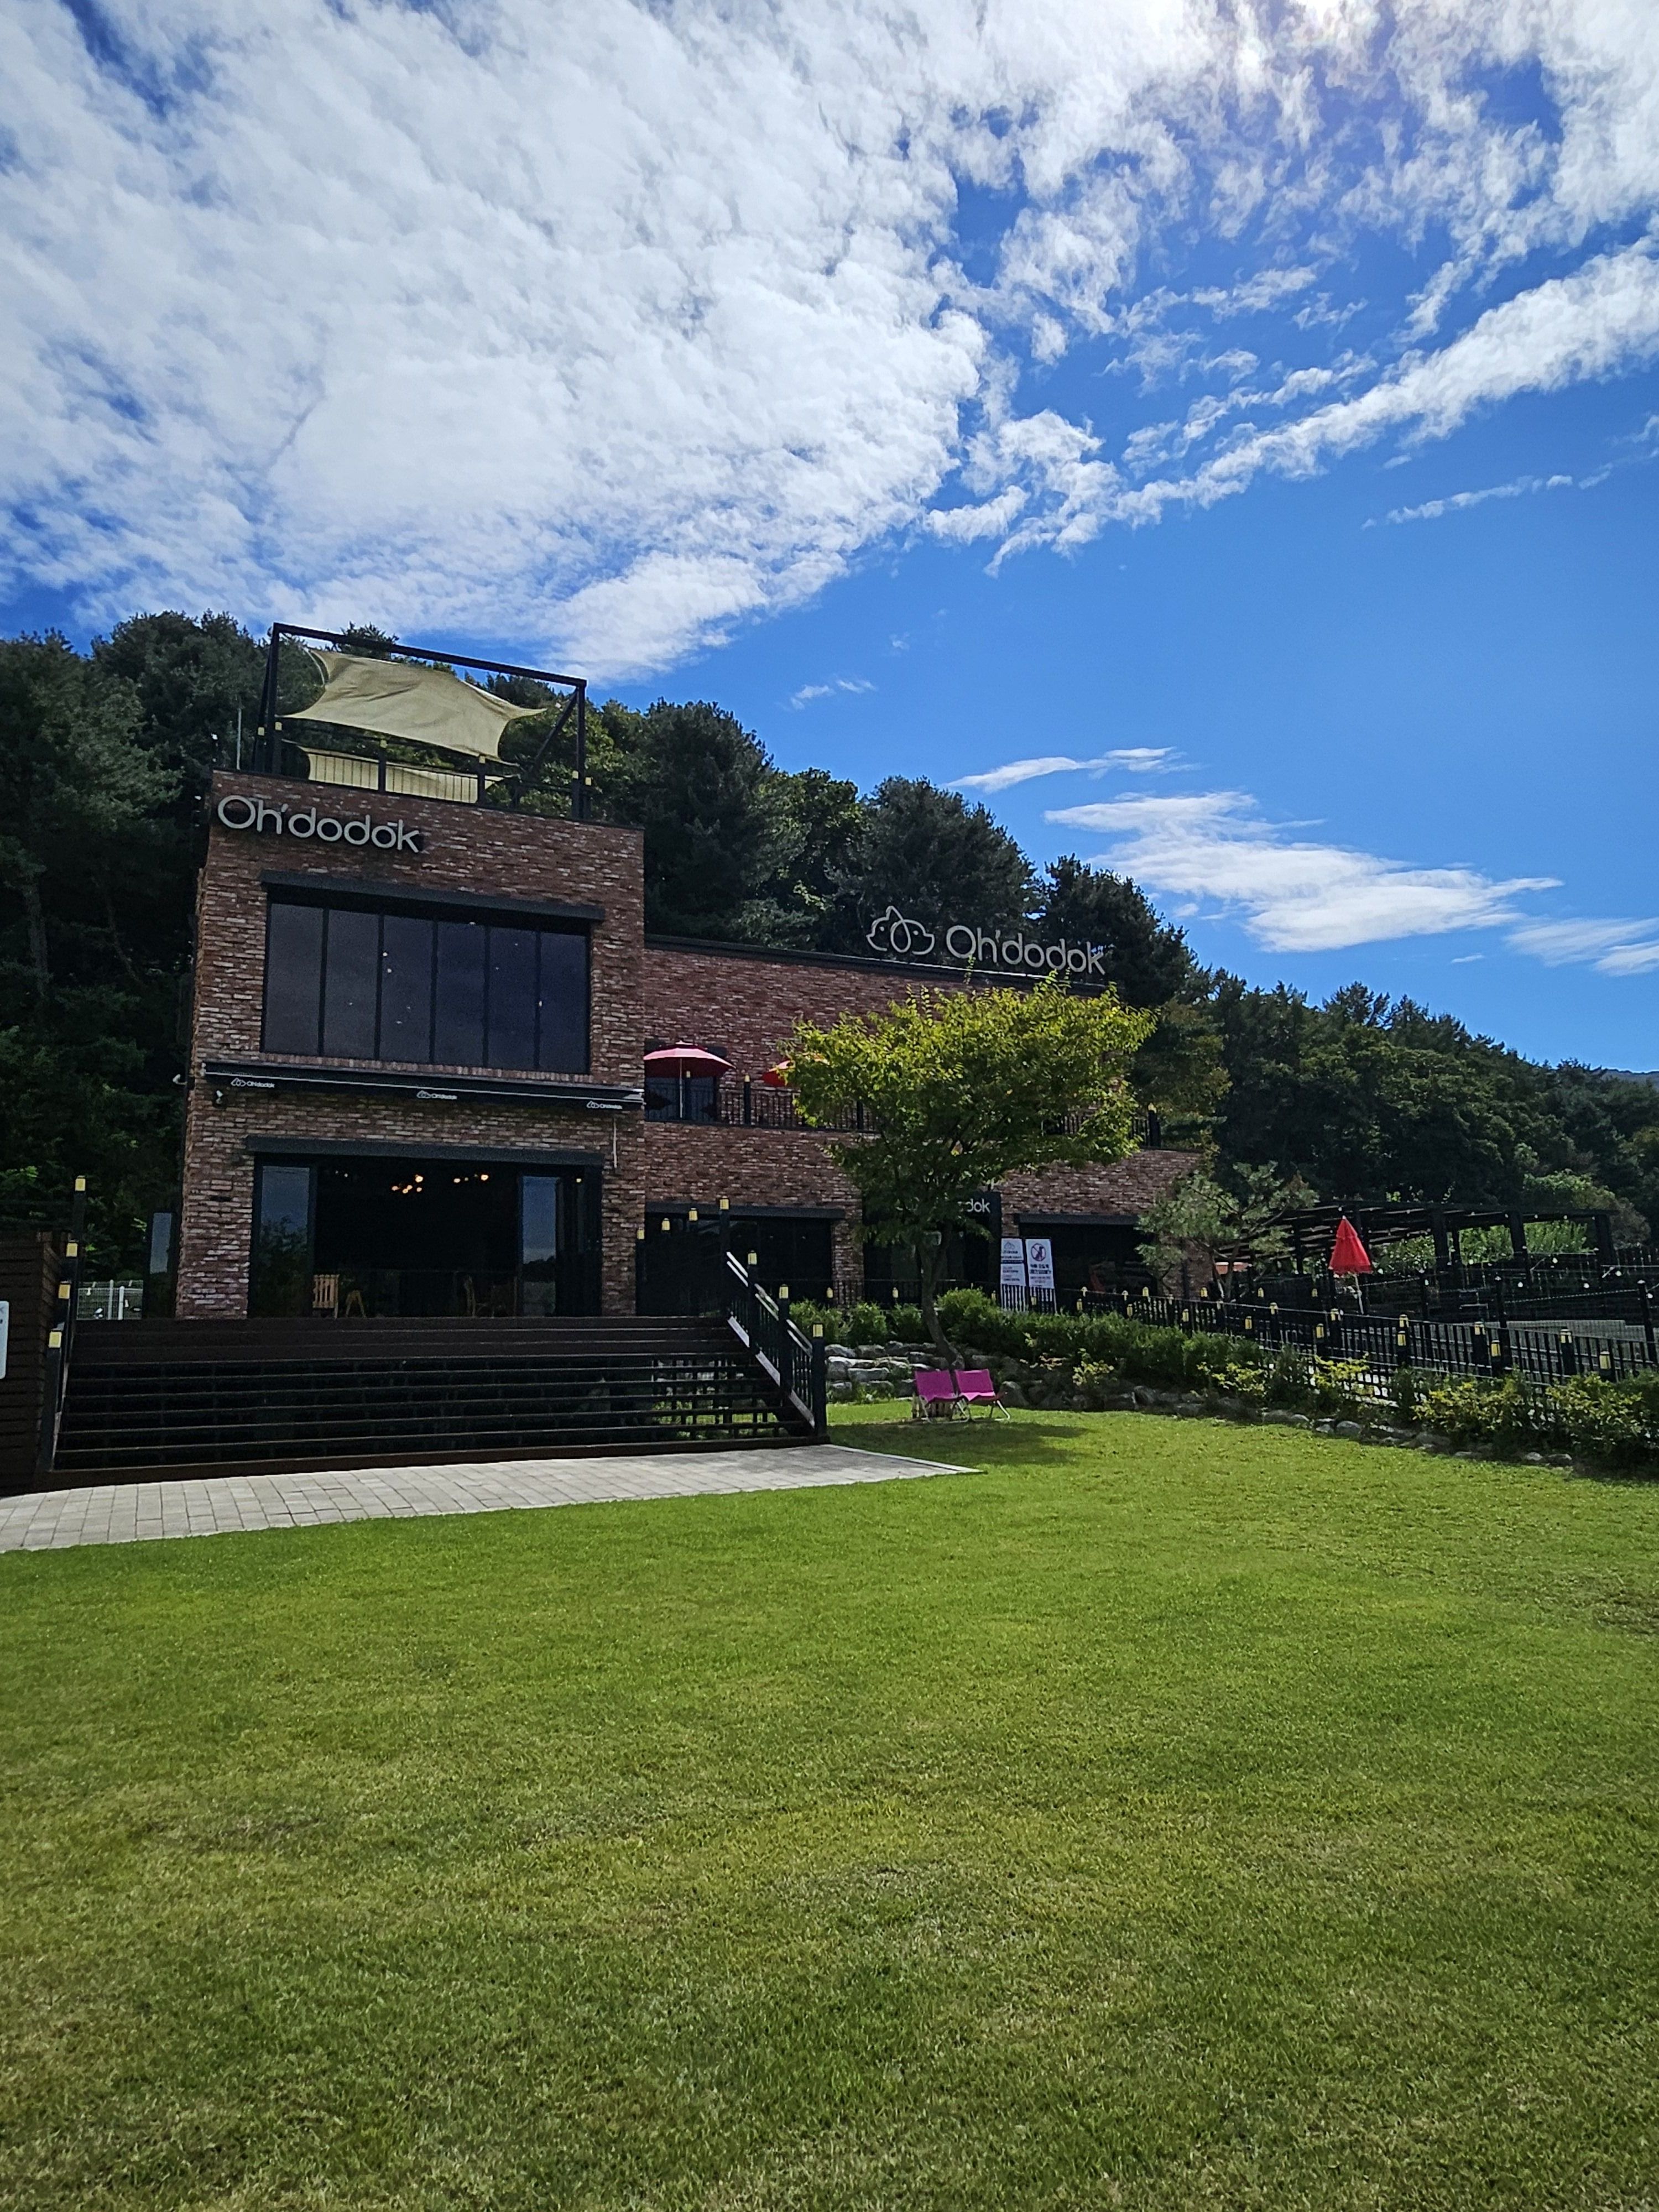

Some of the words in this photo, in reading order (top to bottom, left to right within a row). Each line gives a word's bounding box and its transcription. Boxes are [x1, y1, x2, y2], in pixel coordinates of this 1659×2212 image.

[217, 795, 420, 853] Oh'dodok
[946, 925, 1105, 975] Oh'dodok
[957, 1198, 990, 1213] dok
